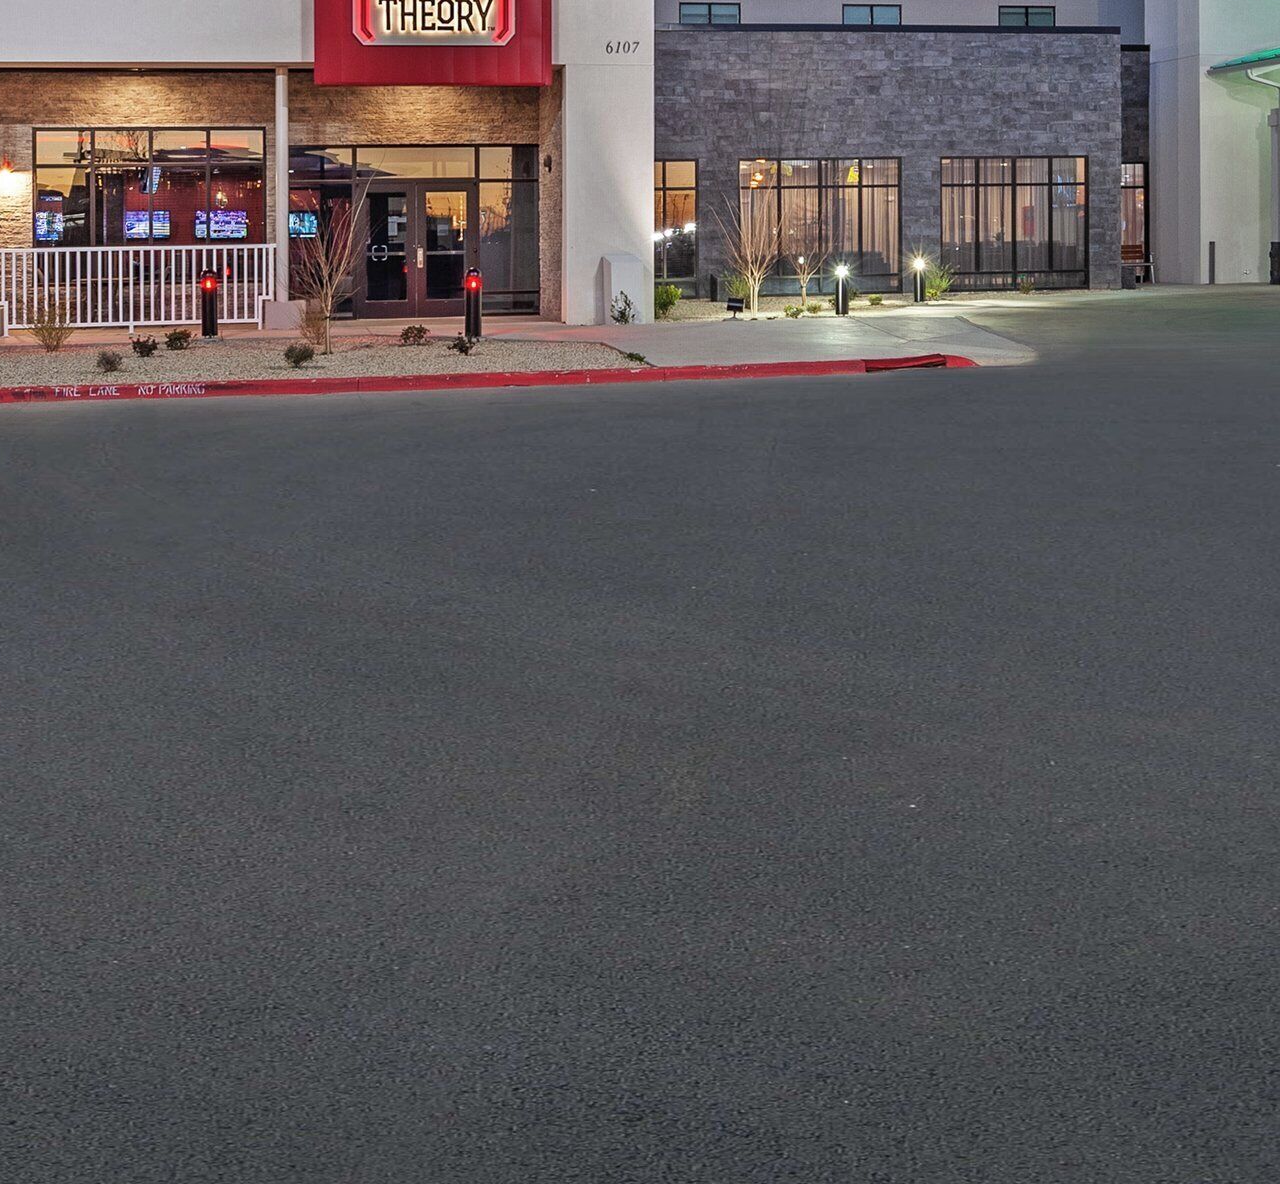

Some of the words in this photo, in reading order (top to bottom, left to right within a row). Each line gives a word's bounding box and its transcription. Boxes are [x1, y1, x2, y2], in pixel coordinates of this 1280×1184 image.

[605, 40, 640, 55] 6107
[53, 386, 81, 398] FIRE
[89, 385, 120, 397] LANE
[138, 384, 157, 396] NO
[158, 383, 205, 396] PARKING
